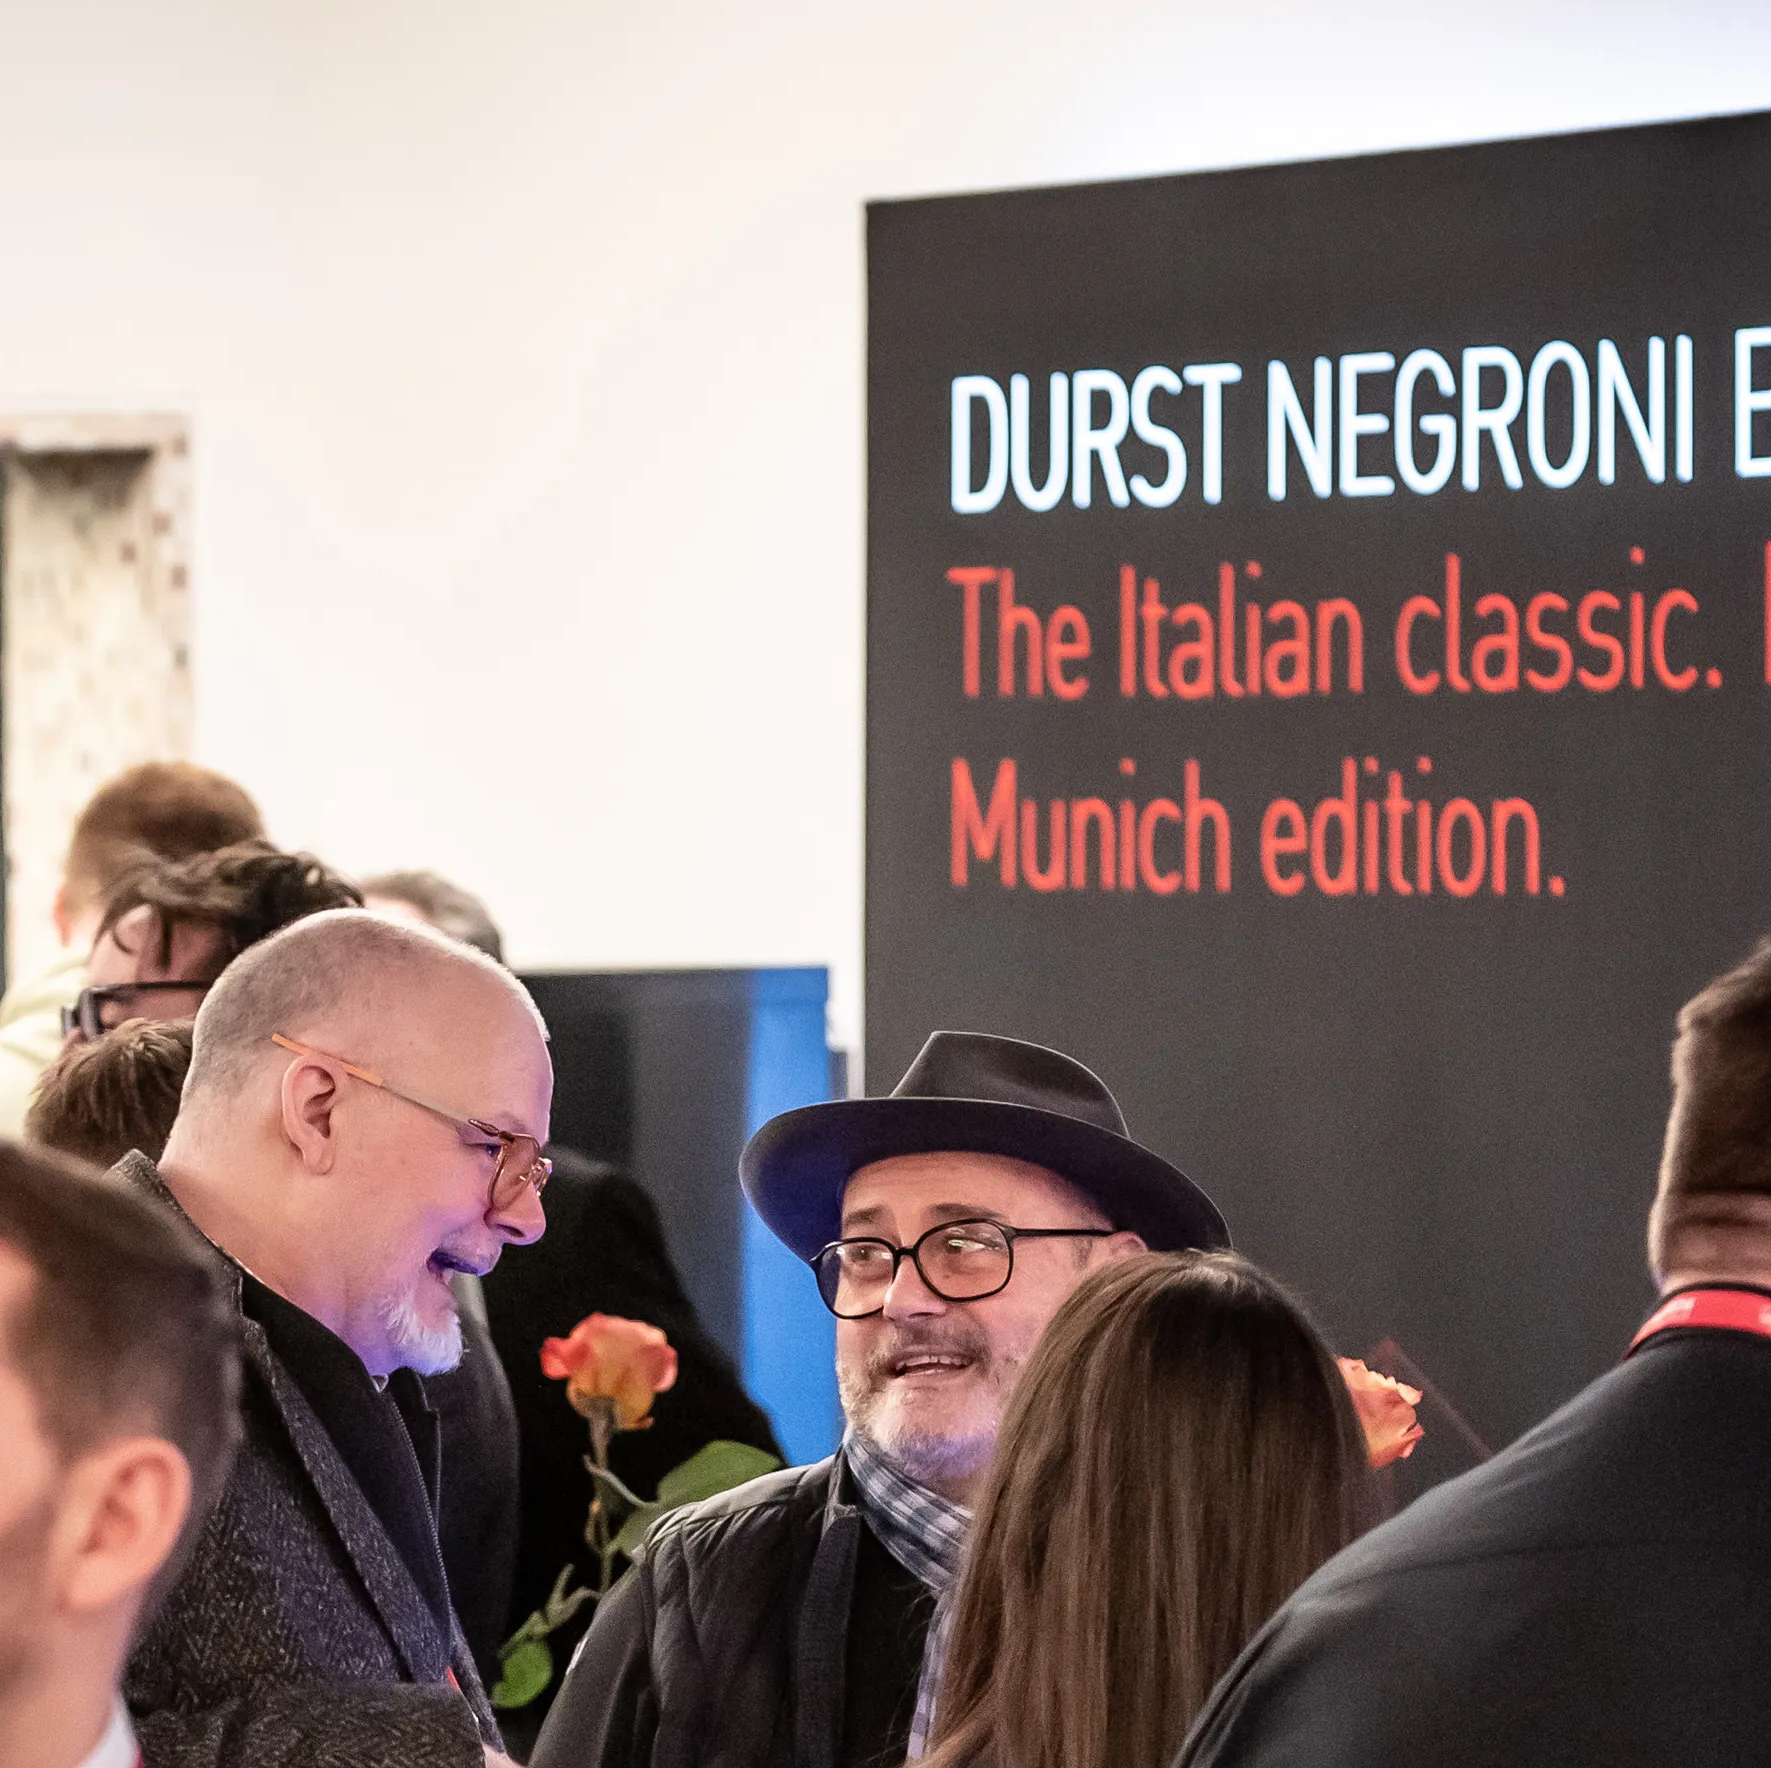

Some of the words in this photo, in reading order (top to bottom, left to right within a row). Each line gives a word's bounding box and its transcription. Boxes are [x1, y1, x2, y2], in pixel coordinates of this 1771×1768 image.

[948, 362, 1243, 515] DURST
[1266, 333, 1695, 502] NEGRONI
[946, 564, 1092, 702] The
[1119, 560, 1366, 701] Italian
[1394, 546, 1724, 696] classic.
[950, 757, 1232, 896] Munich
[1259, 755, 1566, 898] edition.
